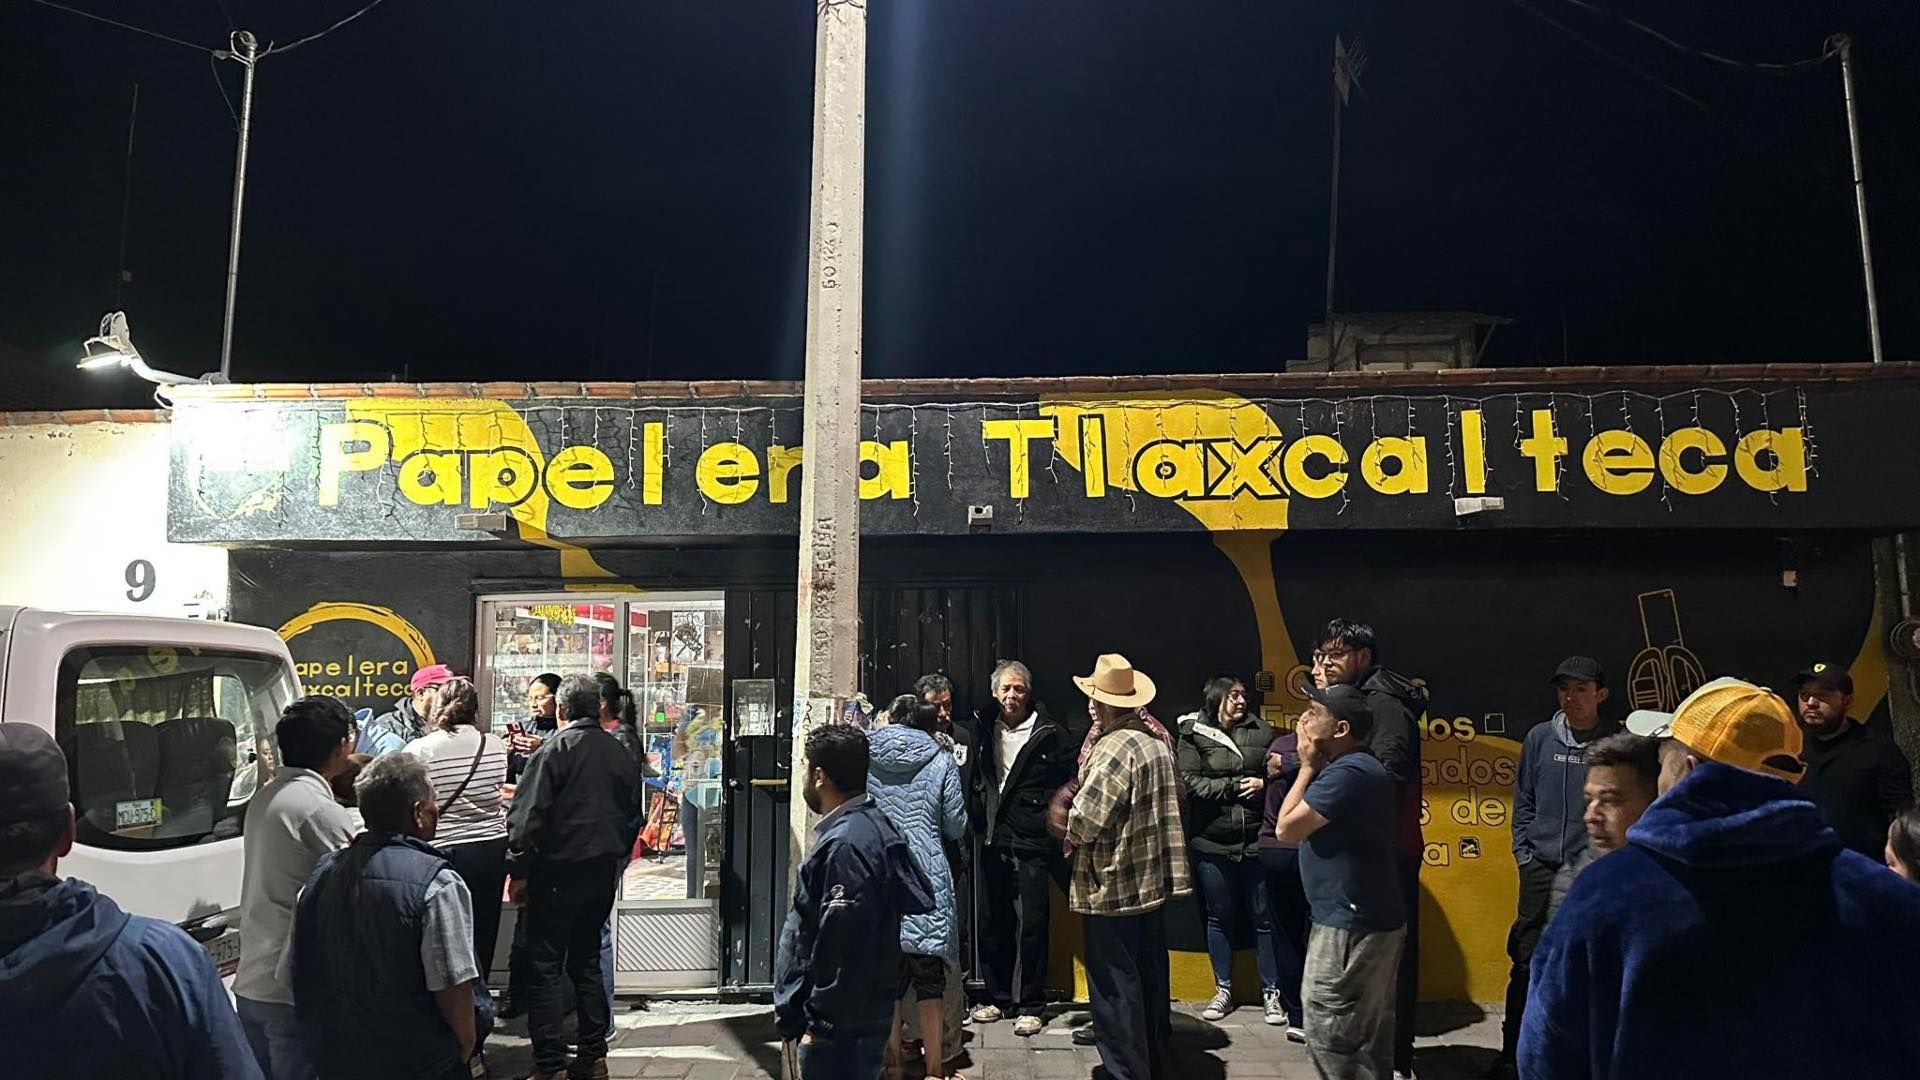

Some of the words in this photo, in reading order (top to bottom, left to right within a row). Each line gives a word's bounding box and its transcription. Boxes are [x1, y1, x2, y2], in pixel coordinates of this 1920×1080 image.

[317, 420, 910, 509] Papelera
[982, 409, 1808, 500] Tlaxcalteca
[125, 559, 156, 602] 9
[296, 654, 408, 678] apelera
[1451, 786, 1507, 827] de
